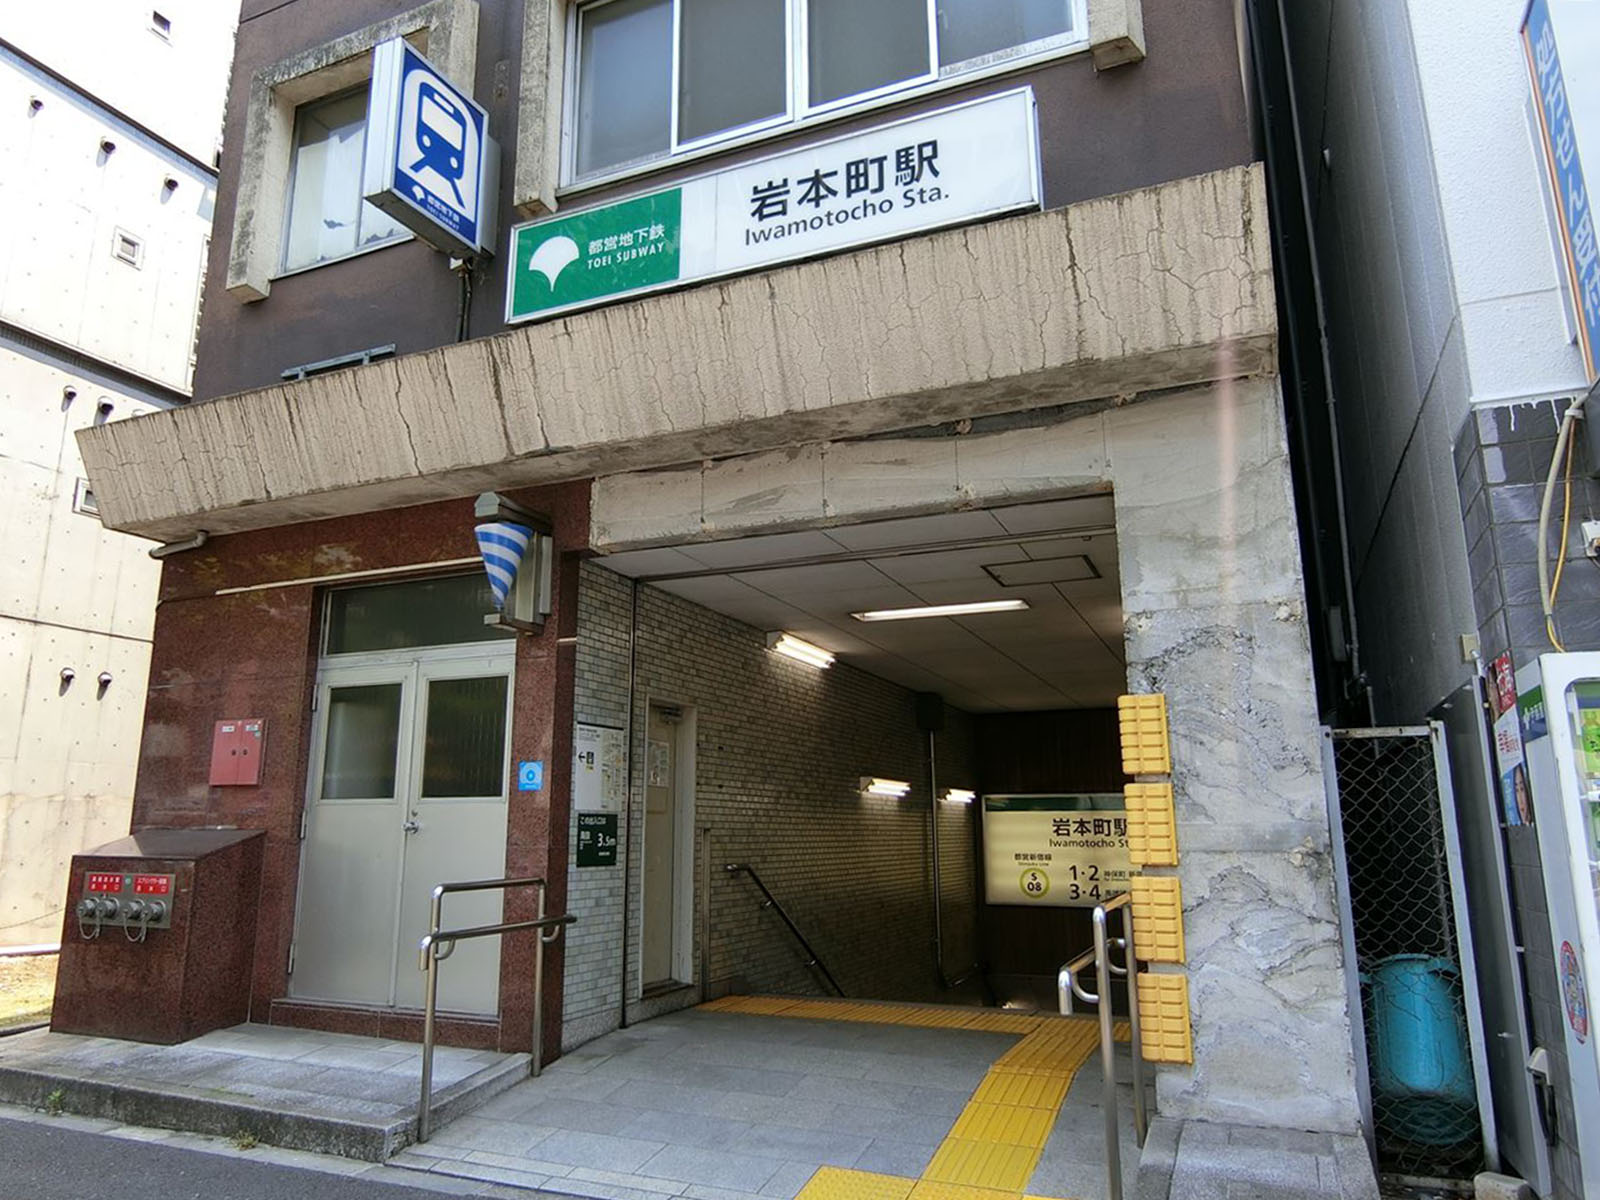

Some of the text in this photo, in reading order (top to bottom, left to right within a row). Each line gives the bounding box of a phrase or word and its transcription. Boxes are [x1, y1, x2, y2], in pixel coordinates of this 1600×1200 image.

[750, 139, 941, 222] 岩本町駅
[745, 186, 950, 246] Iwamotocho Sta.
[588, 224, 665, 256] 都営地下鉄
[587, 241, 665, 270] TOEI SUBWAY
[1049, 838, 1115, 848] Iwamotocho
[1026, 882, 1042, 892] 08
[1031, 872, 1038, 881] S
